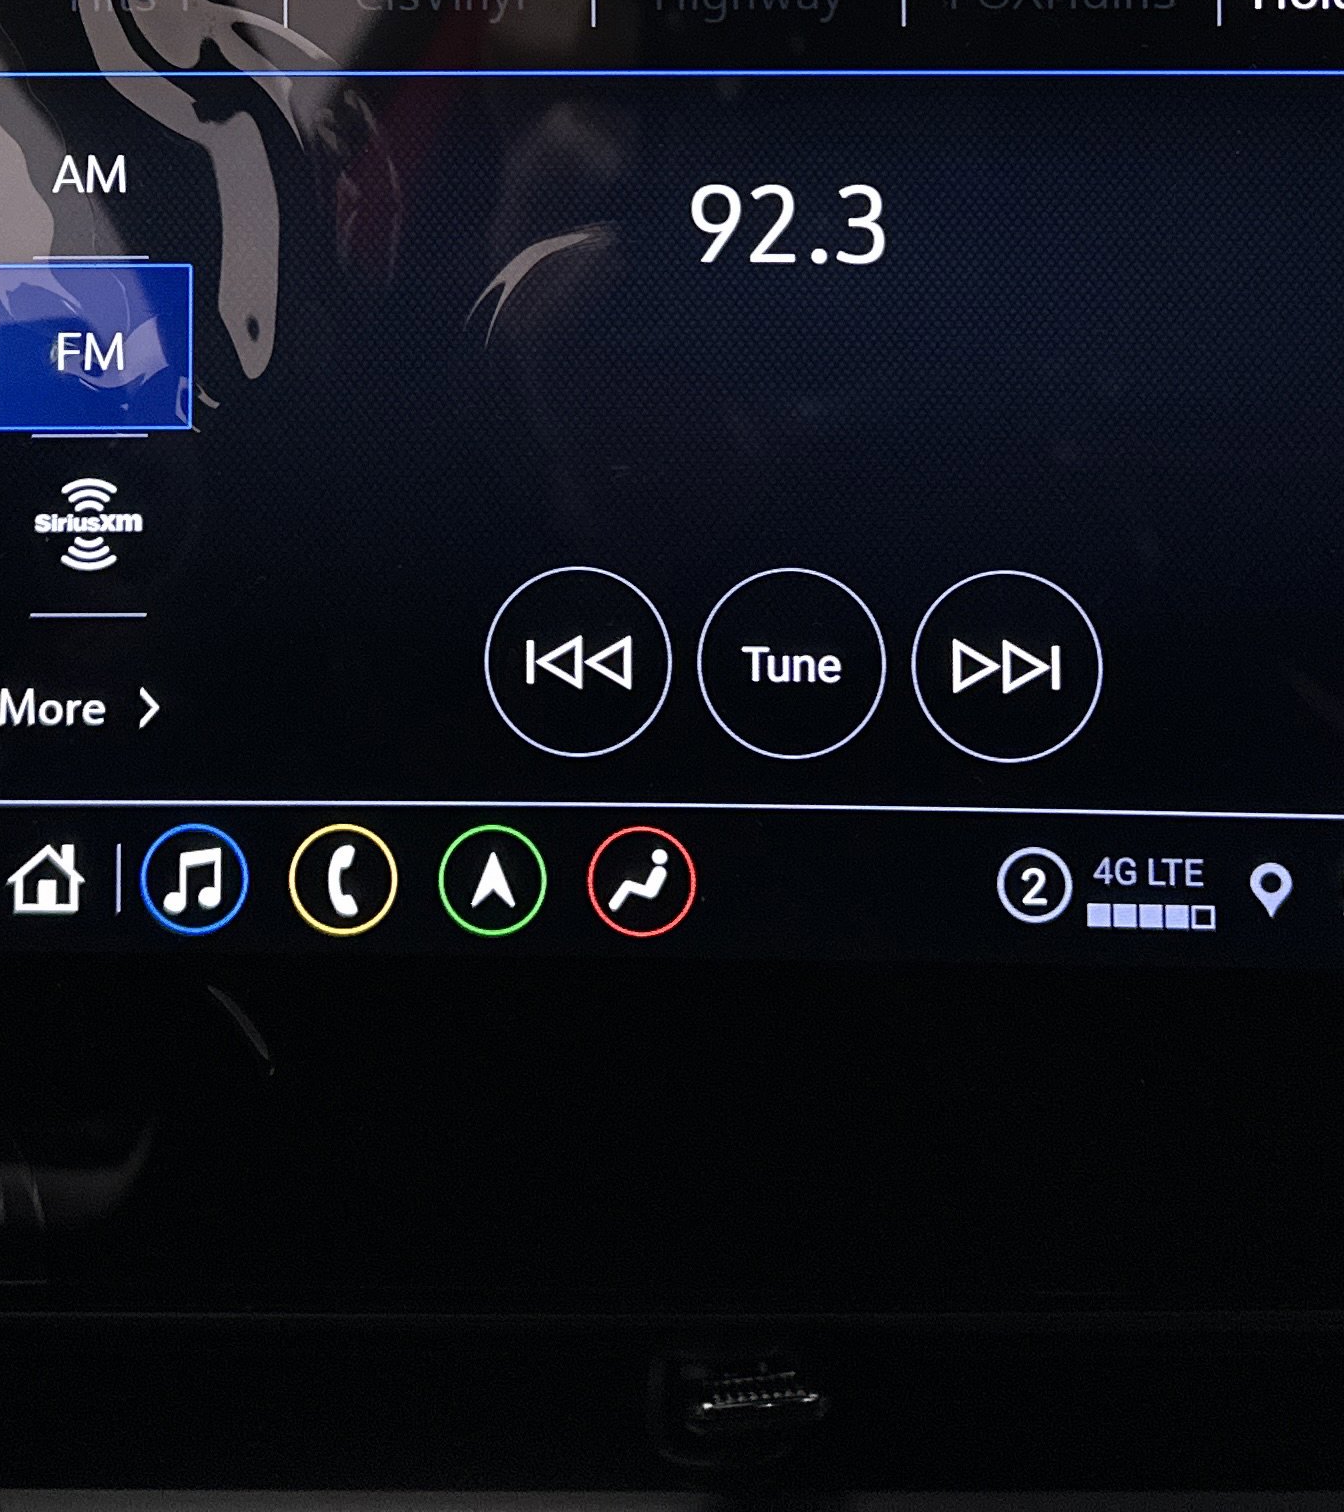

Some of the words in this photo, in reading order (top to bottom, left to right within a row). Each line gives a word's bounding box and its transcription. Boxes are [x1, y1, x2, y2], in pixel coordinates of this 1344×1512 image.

[52, 154, 127, 194] AM
[691, 184, 886, 265] 92.3
[56, 332, 126, 372] FM
[741, 645, 842, 684] Tune
[1019, 867, 1048, 905] 2
[1092, 857, 1137, 886] 4G
[1148, 857, 1205, 887] LTE
